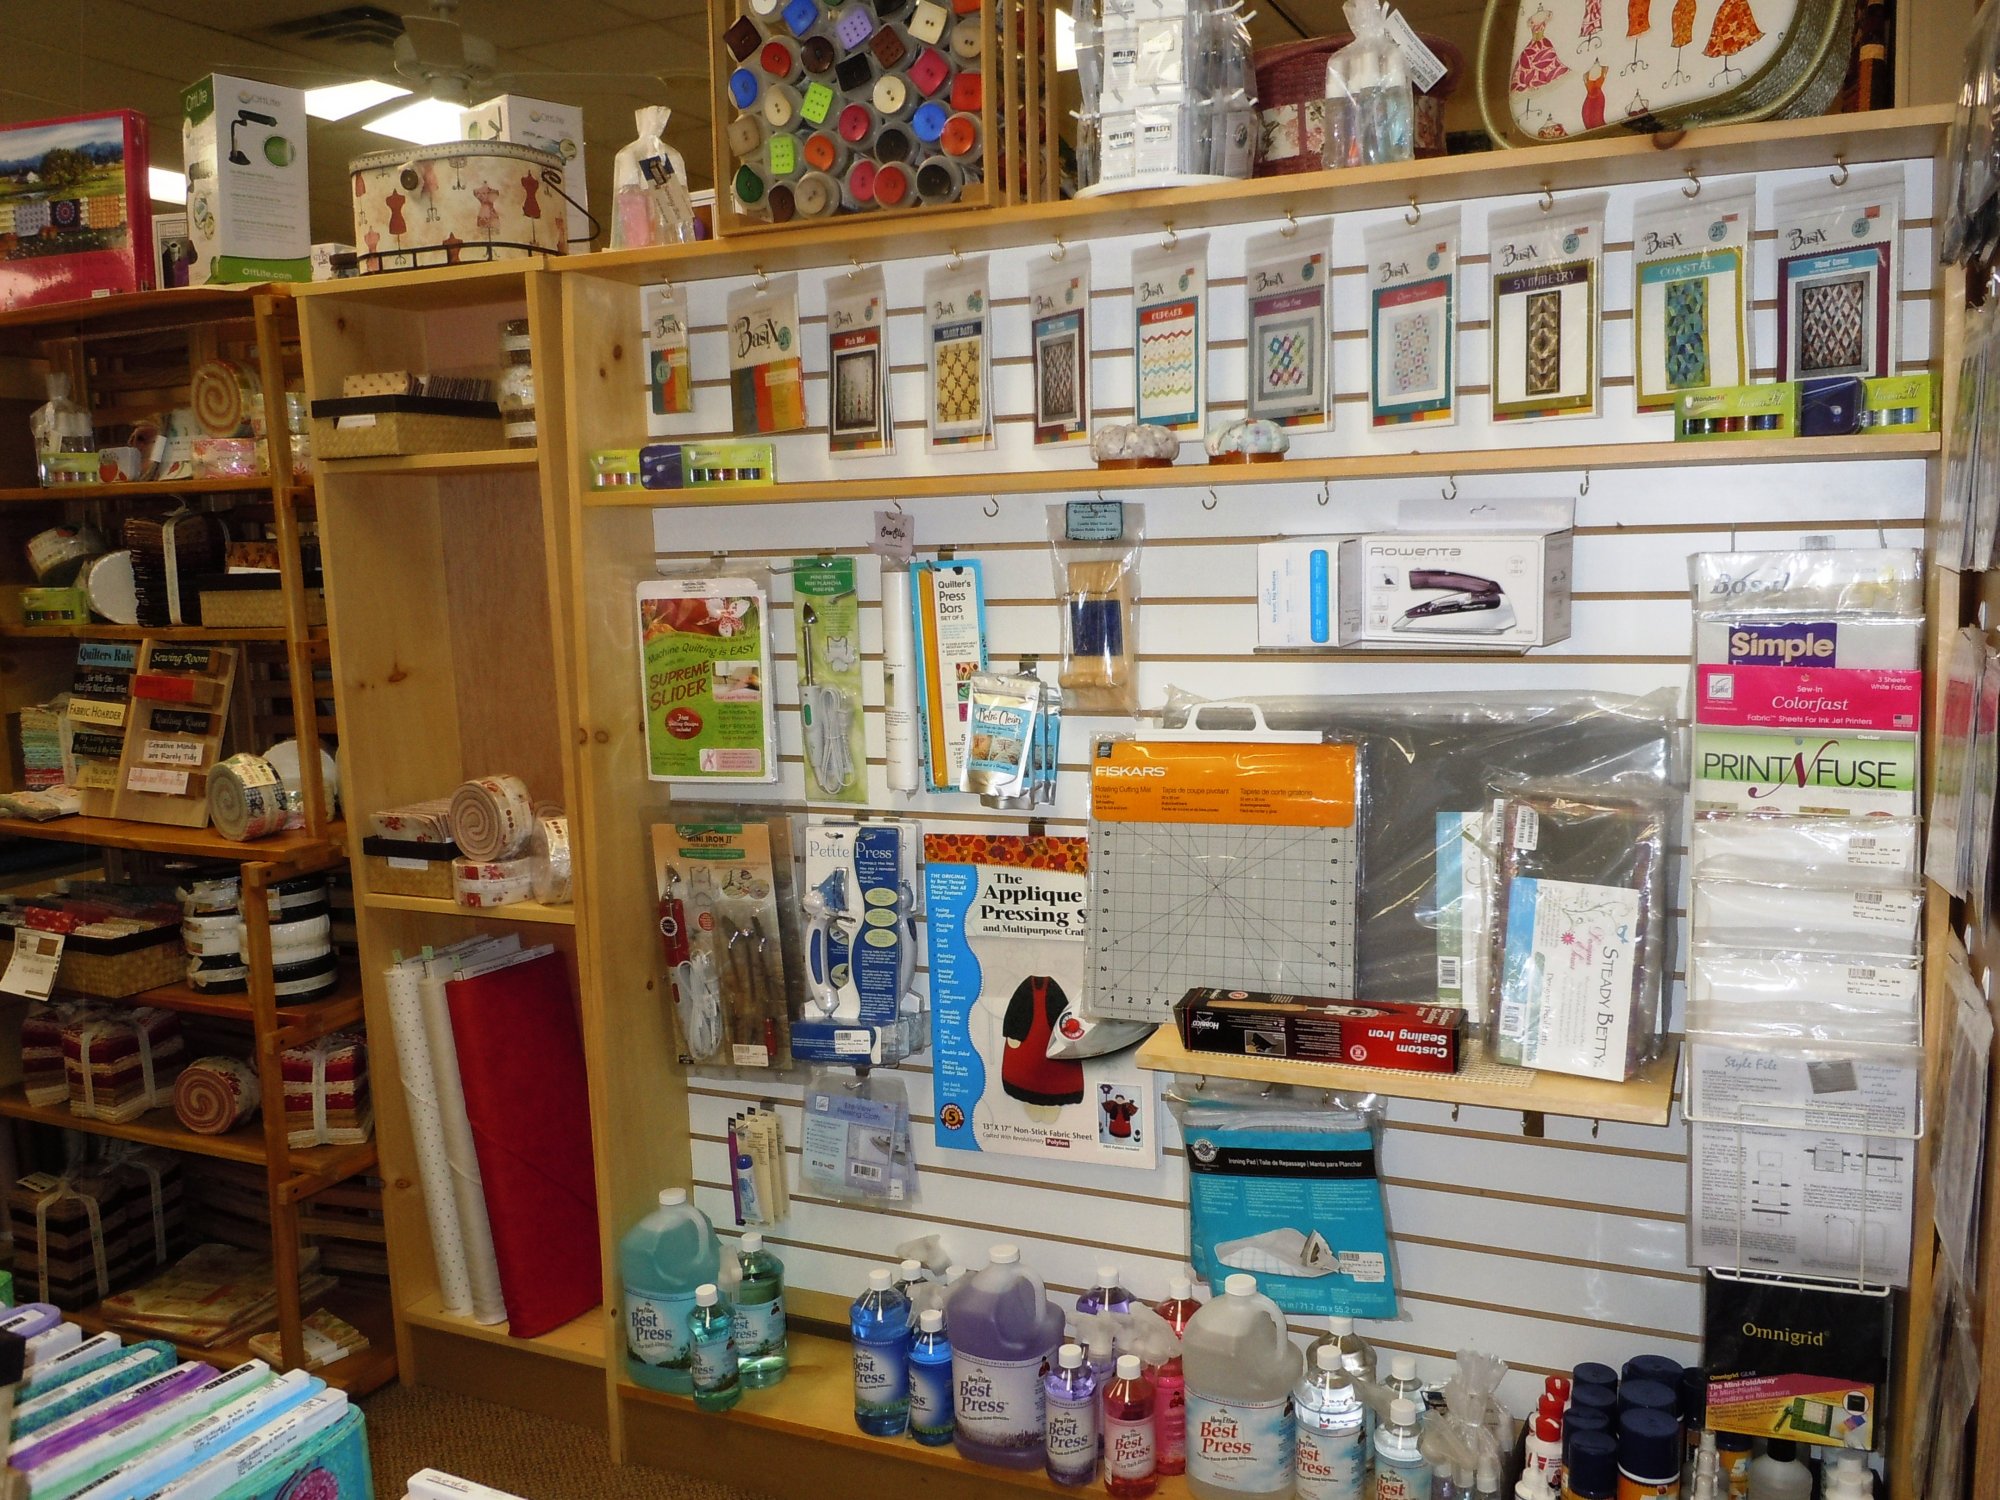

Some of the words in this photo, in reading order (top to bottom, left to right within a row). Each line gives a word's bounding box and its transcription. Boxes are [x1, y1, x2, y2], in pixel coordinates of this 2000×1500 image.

[186, 89, 208, 112] OttLite
[250, 94, 281, 106] OttLite
[1645, 232, 1684, 255] BasiX
[1790, 228, 1828, 251] BasiX
[242, 267, 293, 280] OttLite.com
[1659, 261, 1716, 278] COASTAL
[1513, 268, 1577, 291] SYMMETRY
[737, 316, 780, 359] BasiX
[938, 580, 972, 589] Quilter's
[939, 591, 966, 602] Press
[940, 603, 963, 614] Bars
[79, 647, 112, 662] Quilters
[113, 648, 134, 662] Rule
[648, 645, 680, 664] Machine
[682, 642, 717, 658] Quilting
[730, 643, 755, 656] EASY
[1731, 632, 1835, 664] Simple
[151, 652, 183, 666] Sewing
[184, 652, 209, 664] Room
[650, 660, 710, 690] SUPREME
[1884, 676, 1906, 684] Sheets
[650, 678, 707, 712] SLIDER
[1772, 695, 1849, 713] Colorfast
[69, 704, 91, 718] FABRIC
[92, 705, 122, 720] HOARDER
[1779, 715, 1803, 723] Sheets
[1845, 717, 1872, 725] Printers
[961, 734, 966, 742] 5
[161, 752, 181, 761] Rarely
[184, 754, 197, 762] Tidy
[1095, 766, 1166, 777] FISKARS
[1816, 759, 1897, 789] FUSE
[1120, 785, 1139, 794] Cutting
[1331, 837, 1339, 845] 9
[809, 840, 850, 857] Petite
[855, 841, 892, 859] Press
[994, 872, 1023, 885] The
[982, 884, 1083, 907] Applique
[980, 904, 1070, 928] Pressing
[983, 924, 1000, 932] and
[1002, 924, 1063, 937] Multipurpose
[1598, 945, 1619, 1009] STEADY
[1368, 1028, 1394, 1041] Iron
[1398, 1029, 1447, 1046] Sealing
[1593, 1011, 1615, 1064] BETTY
[1396, 1044, 1447, 1058] Custom
[1724, 1056, 1752, 1073] Style
[1755, 1057, 1777, 1071] File
[948, 1110, 956, 1122] 5
[945, 1121, 961, 1130] Years
[982, 1132, 1000, 1140] Coated
[1012, 1135, 1044, 1145] Revolutionary
[1014, 1127, 1048, 1137] Non-Stick
[1049, 1130, 1071, 1139] Fabric
[1072, 1132, 1093, 1141] Sheet
[1229, 1158, 1246, 1167] Ironing
[1279, 1160, 1306, 1168] Repassage
[1299, 1303, 1314, 1312] 71.7
[1334, 1305, 1350, 1314] 55.2
[631, 1311, 657, 1328] Best
[636, 1326, 673, 1342] Press
[1742, 1321, 1824, 1347] Omnigrid
[1709, 1372, 1739, 1381] Omnigrid
[960, 1381, 992, 1397] Best
[1709, 1383, 1722, 1391] The
[961, 1396, 1006, 1413] Press
[1049, 1422, 1077, 1436] Best
[1200, 1422, 1239, 1438] Best
[1050, 1434, 1088, 1449] Press
[1115, 1436, 1143, 1450] Best
[1202, 1438, 1252, 1455] Press
[1116, 1444, 1151, 1462] Press
[1296, 1460, 1331, 1476] Press
[1376, 1479, 1406, 1496] Best
